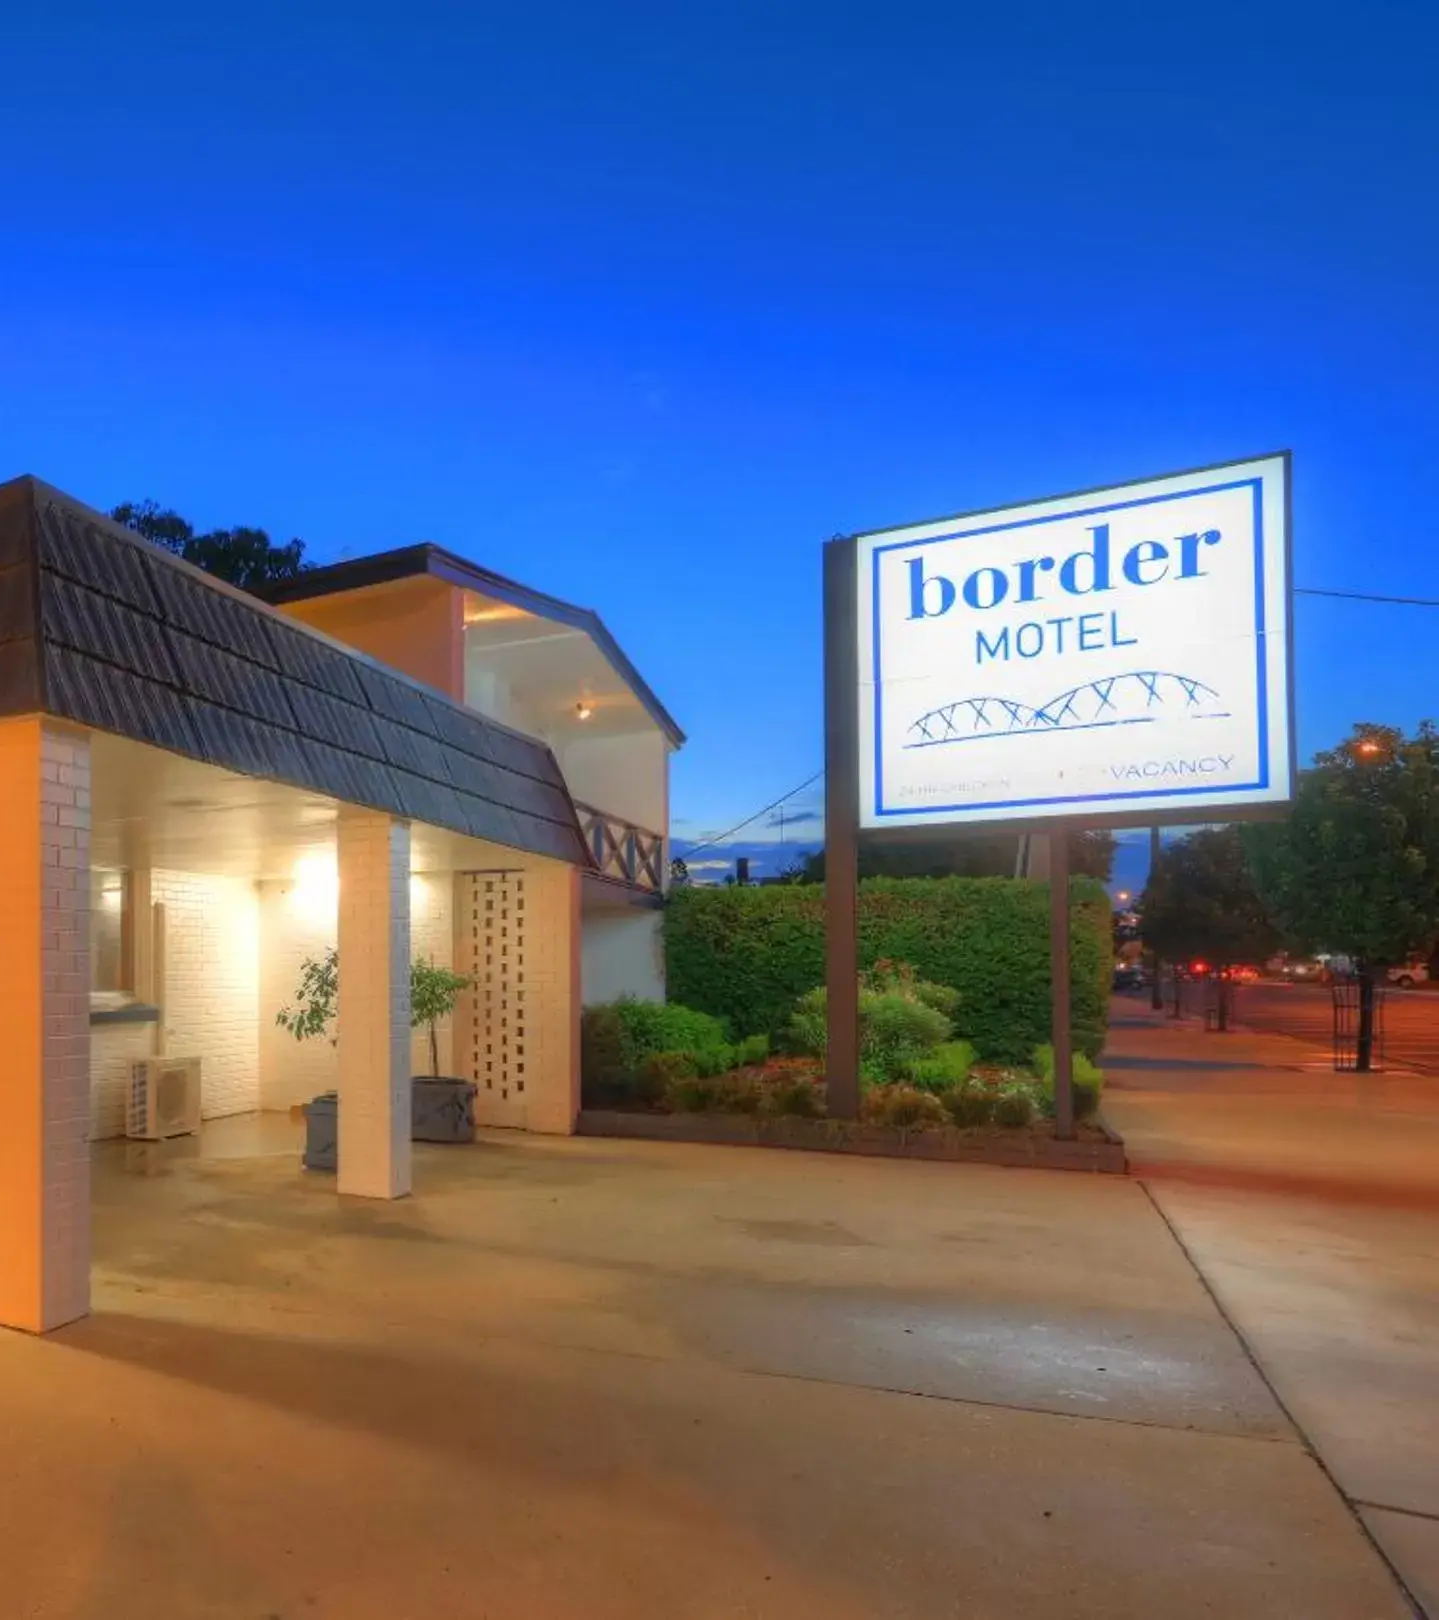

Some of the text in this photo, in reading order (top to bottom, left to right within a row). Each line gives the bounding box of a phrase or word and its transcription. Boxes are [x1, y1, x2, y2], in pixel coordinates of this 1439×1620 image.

[904, 523, 1222, 620] border
[976, 611, 1138, 664] MOTEL
[1110, 755, 1235, 780] VACANCY
